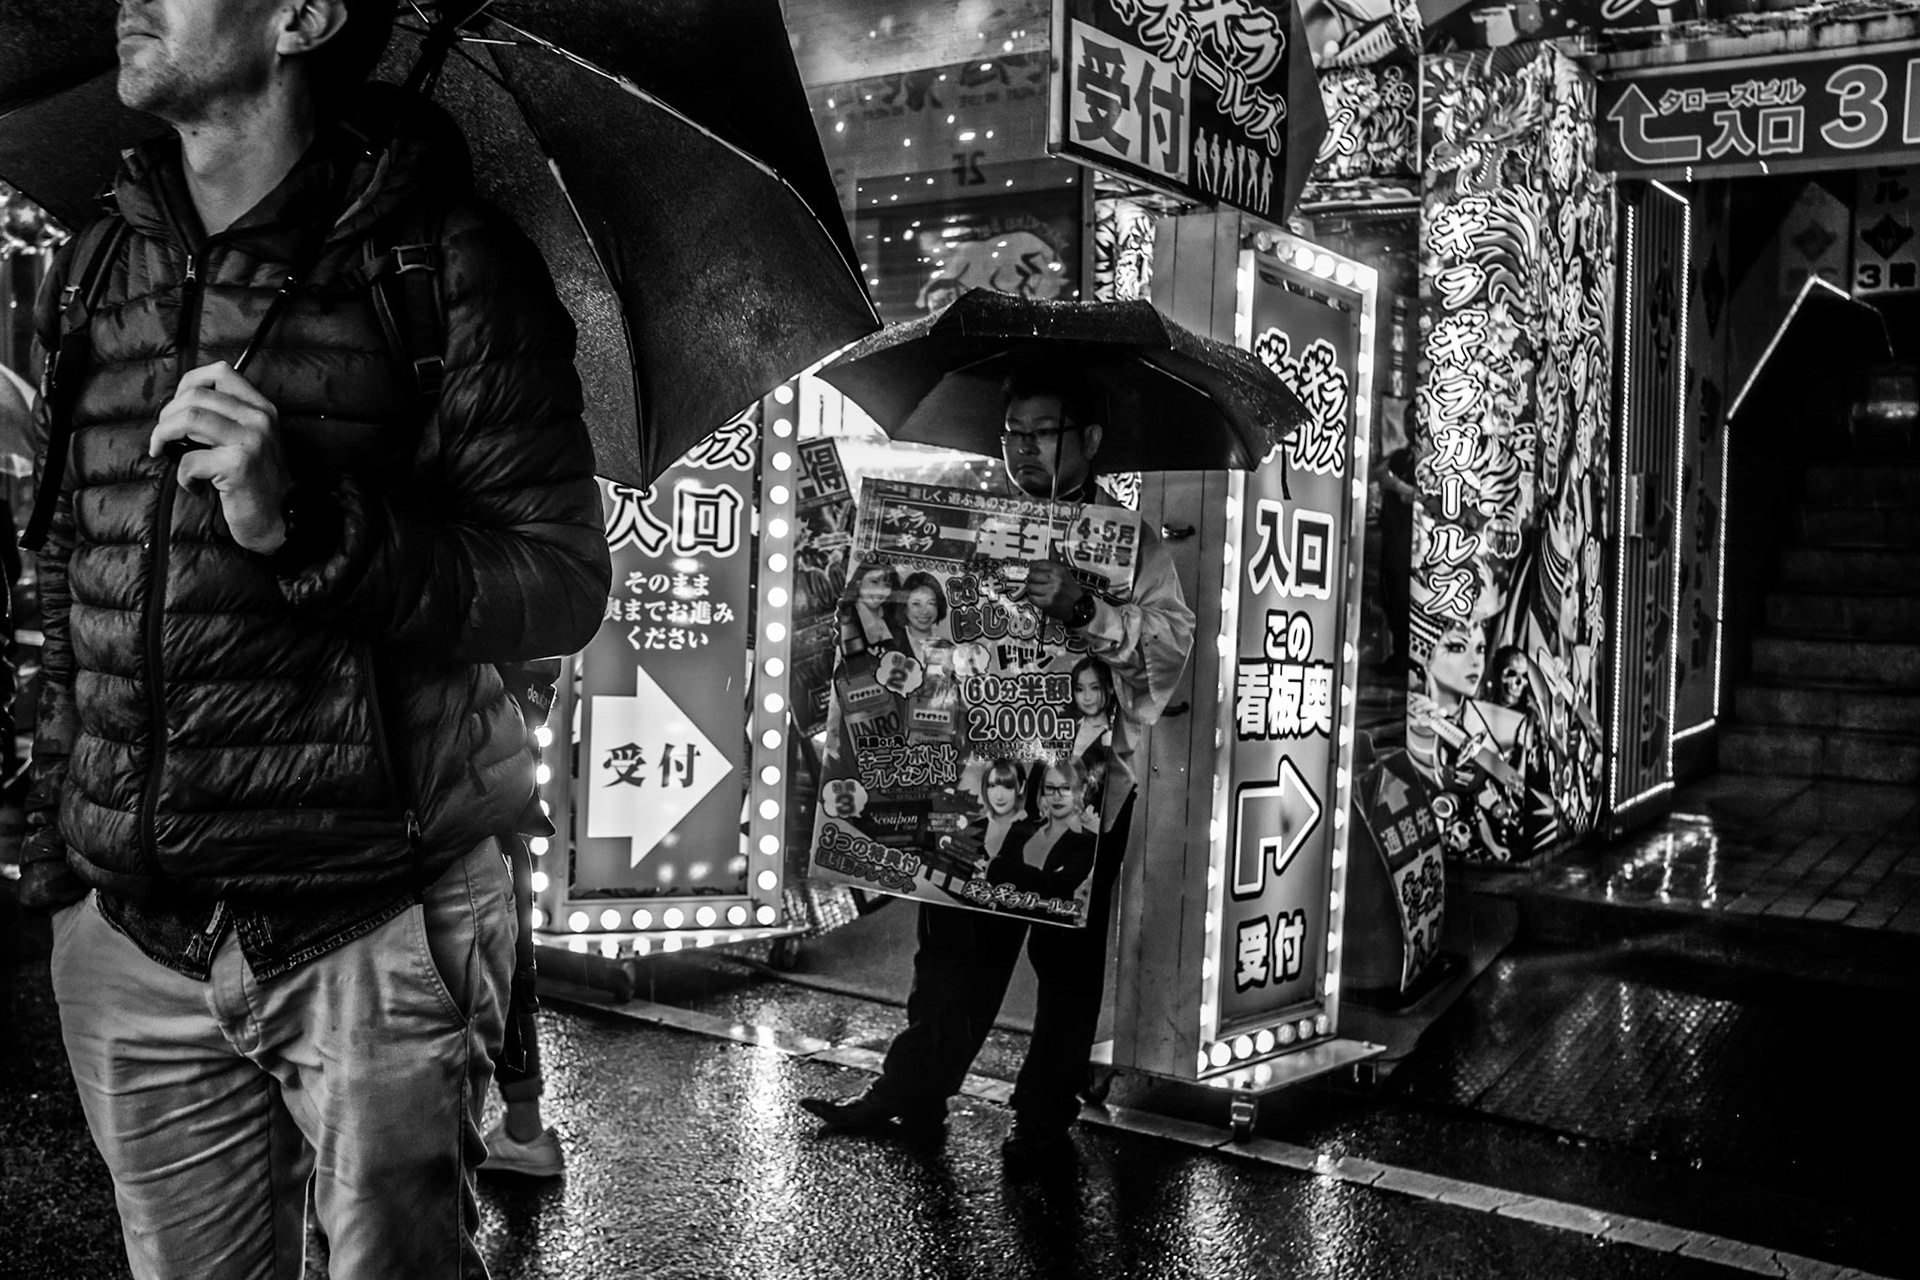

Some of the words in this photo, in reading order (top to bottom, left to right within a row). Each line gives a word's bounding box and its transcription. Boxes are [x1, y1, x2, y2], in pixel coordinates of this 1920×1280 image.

[1074, 36, 1184, 173] 受付
[1158, 13, 1287, 156] ガールズ
[1659, 78, 1806, 116] タローズビル
[1820, 58, 1920, 149] 3
[1706, 106, 1805, 159] 入口
[1426, 197, 1491, 616] ギラギラガールズ
[606, 483, 744, 557] 入口
[1250, 499, 1335, 600] 入口
[604, 596, 735, 625] 奥までお進み
[625, 571, 710, 596] そのまま
[626, 624, 710, 650] ください
[1263, 608, 1313, 663] この
[966, 673, 1073, 705] 60分半額
[1236, 660, 1335, 741] 看板奥
[967, 705, 1076, 742] 2,000円
[601, 740, 702, 789] 受付
[1235, 909, 1307, 993] 受付
